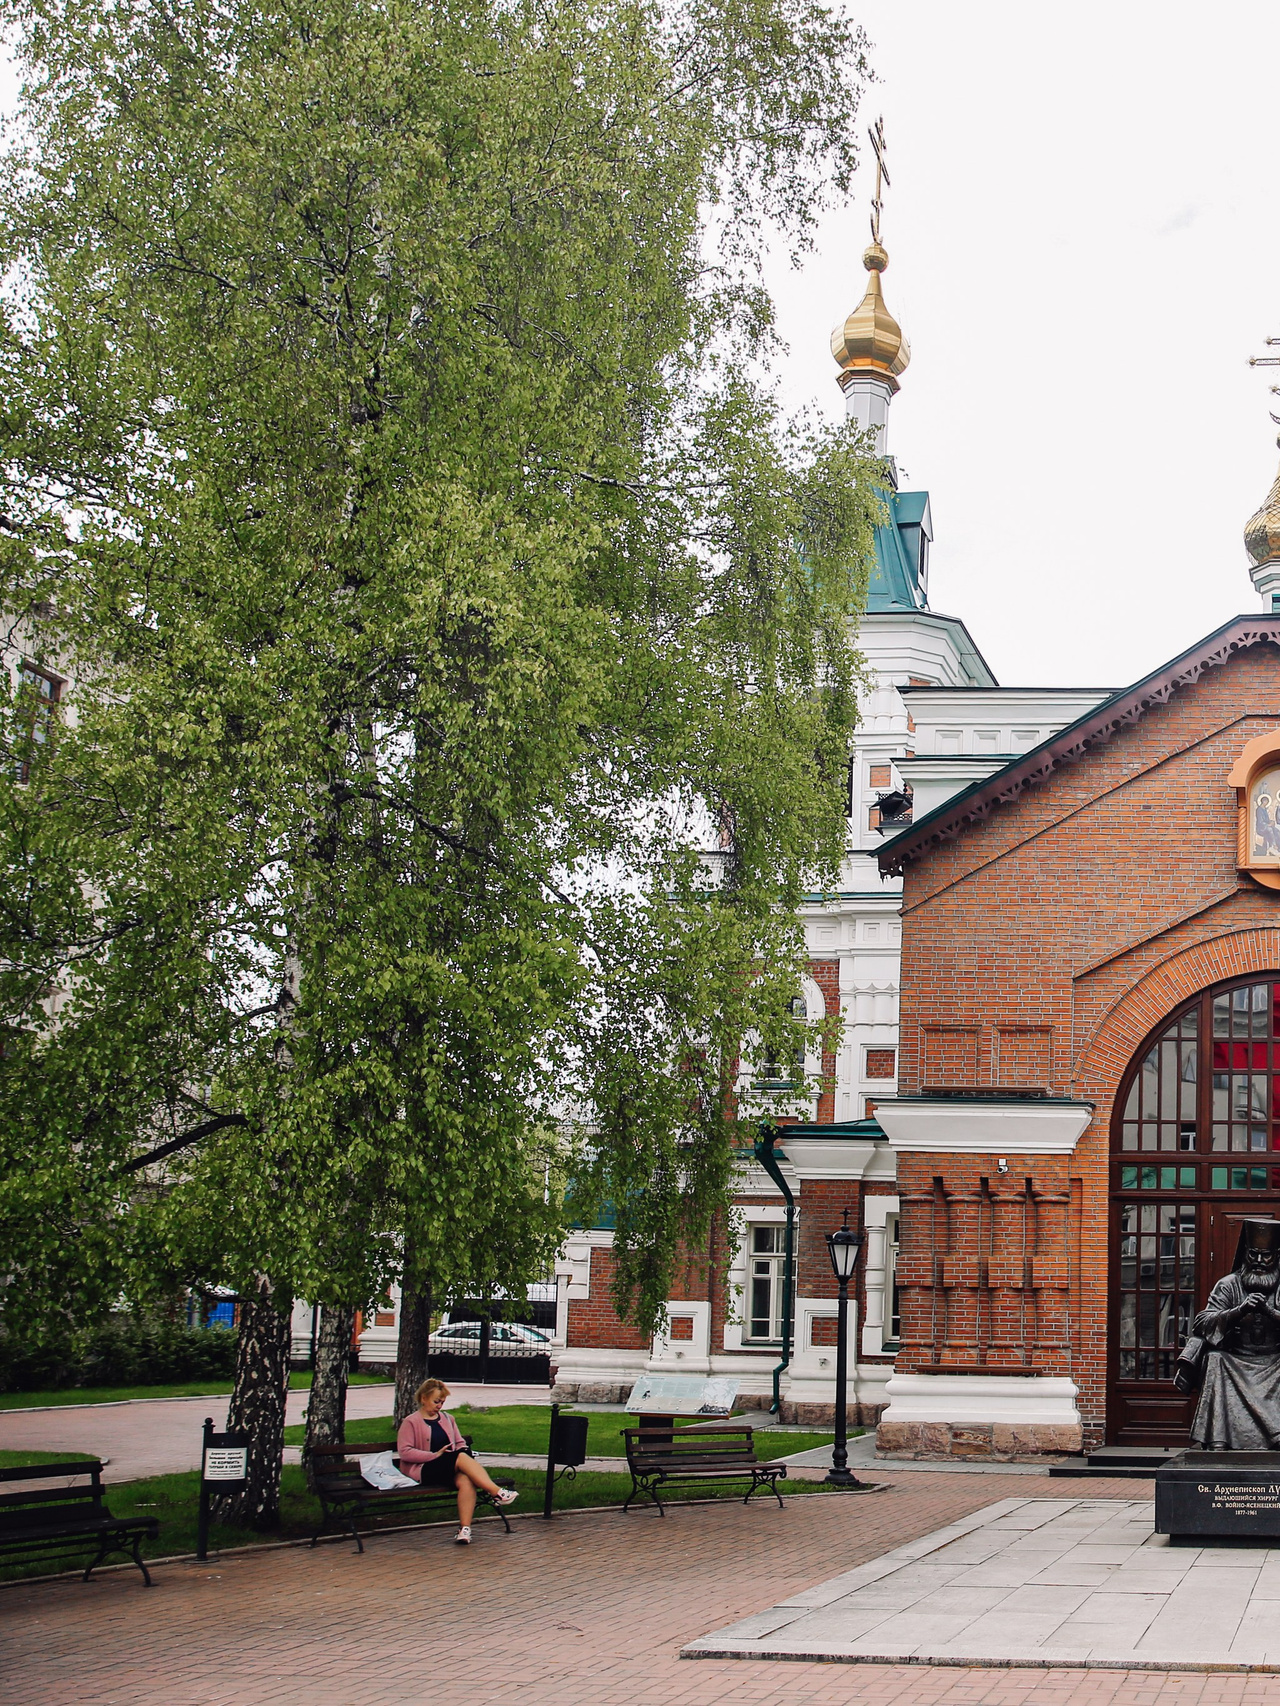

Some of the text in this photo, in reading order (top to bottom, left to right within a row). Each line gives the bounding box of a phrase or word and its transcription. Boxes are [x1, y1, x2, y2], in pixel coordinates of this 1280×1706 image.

[1197, 1484, 1212, 1493] Св.
[1214, 1484, 1266, 1495] Архиепископ
[1225, 1501, 1280, 1509] ВОЙНО-ЯСЕНЕЦКИЙ
